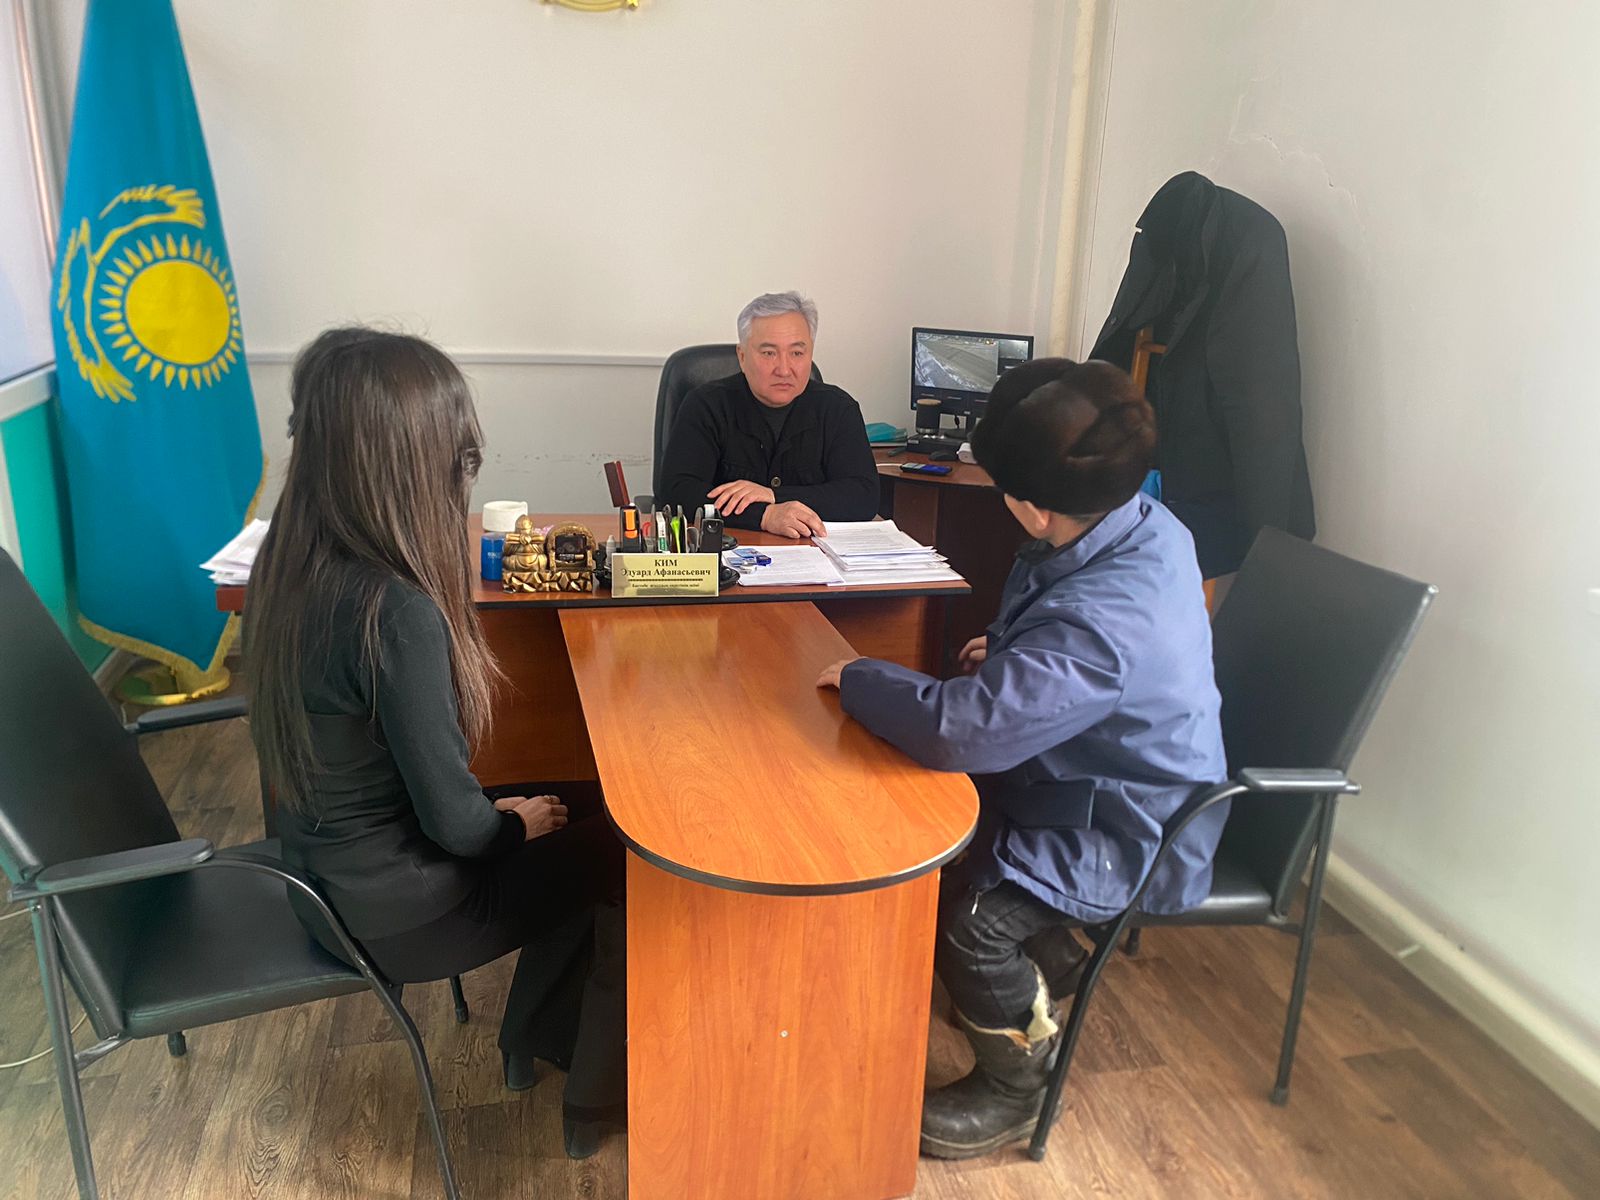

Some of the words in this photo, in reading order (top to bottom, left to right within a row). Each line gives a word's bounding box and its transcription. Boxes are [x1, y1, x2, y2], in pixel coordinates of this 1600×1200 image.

[654, 559, 678, 567] КИМ
[620, 568, 652, 577] Эдуард
[653, 568, 711, 577] Афанасьевич
